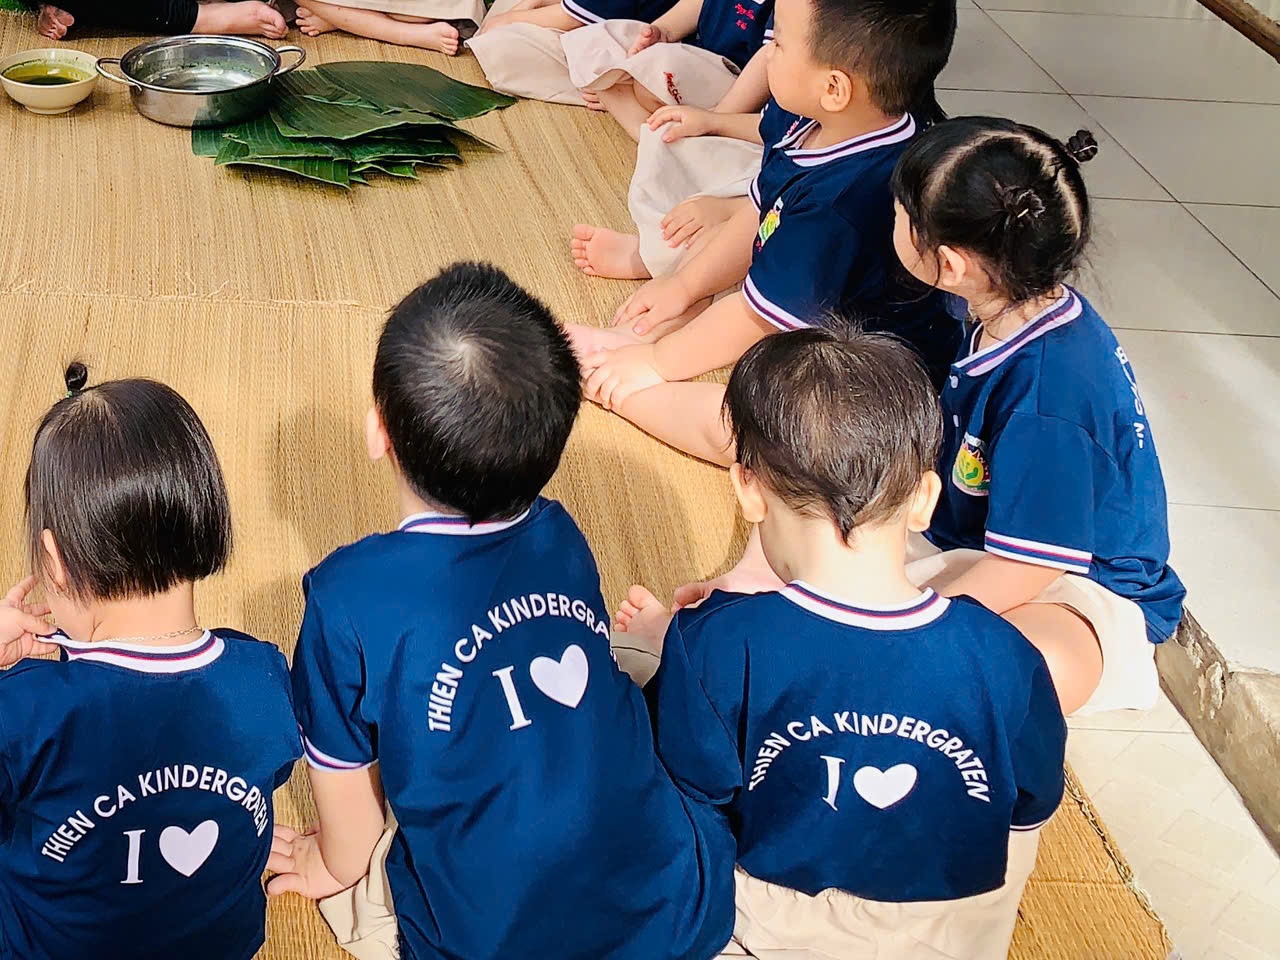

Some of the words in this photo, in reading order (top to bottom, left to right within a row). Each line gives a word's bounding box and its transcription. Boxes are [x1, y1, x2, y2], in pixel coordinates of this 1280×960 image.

[428, 662, 464, 732] THIEN
[454, 623, 493, 663] CA
[492, 665, 533, 731] I
[748, 732, 791, 792] THIEN
[786, 715, 833, 741] CA
[833, 711, 991, 804] KINDERGRATEN
[820, 755, 846, 812] I
[41, 809, 96, 863] THIEN
[93, 784, 136, 818] CA
[120, 829, 146, 884] I
